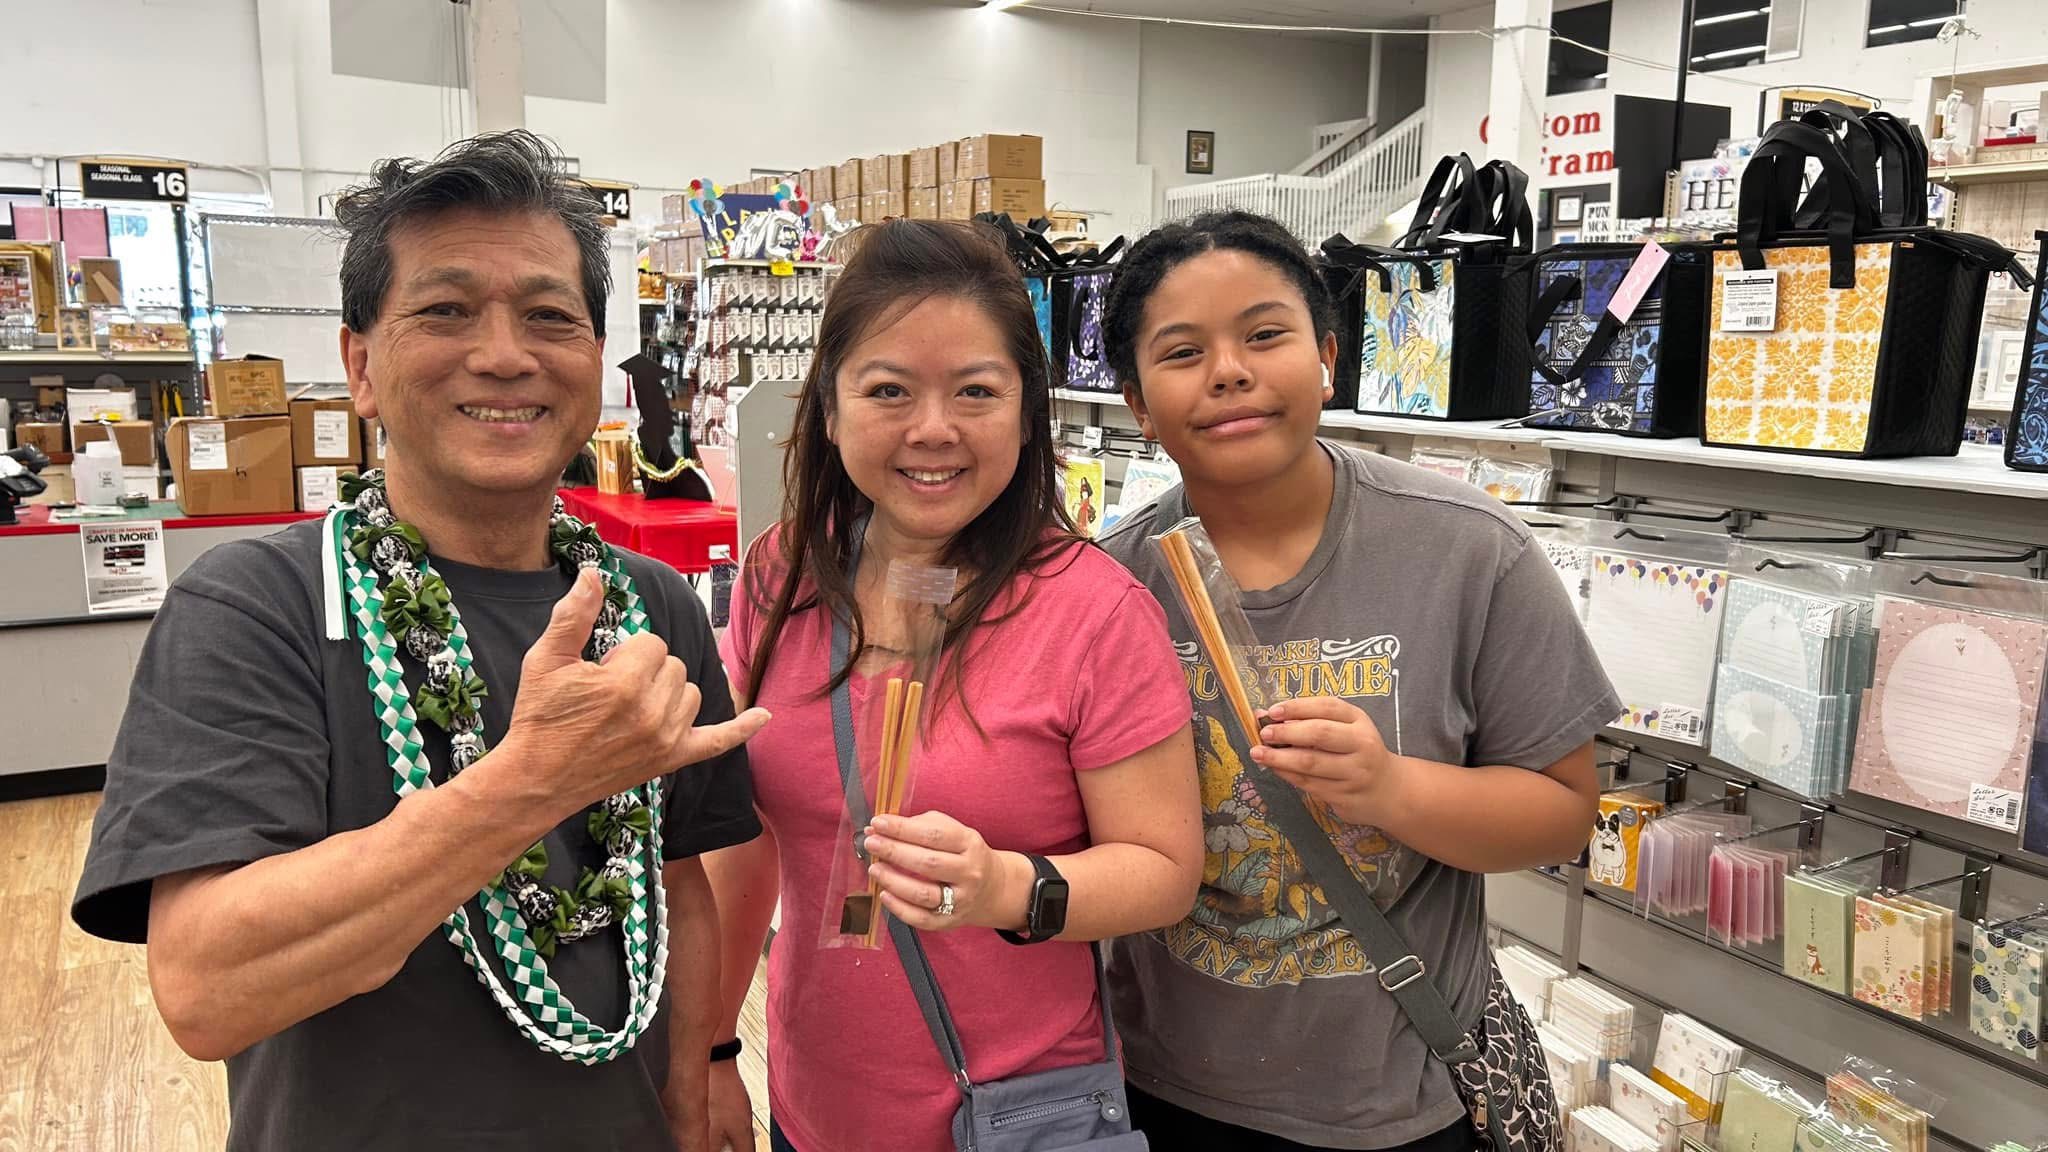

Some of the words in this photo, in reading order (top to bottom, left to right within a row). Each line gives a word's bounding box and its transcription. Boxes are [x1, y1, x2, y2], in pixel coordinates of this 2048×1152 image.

[91, 173, 122, 181] SEASONAL
[123, 174, 143, 182] GLASS
[100, 165, 131, 174] SEASONAL
[152, 172, 186, 197] 16
[603, 192, 629, 215] 14
[86, 533, 117, 545] SAVE
[119, 531, 158, 542] MORE!
[1256, 638, 1320, 662] TAKE
[1268, 653, 1393, 700] TIME
